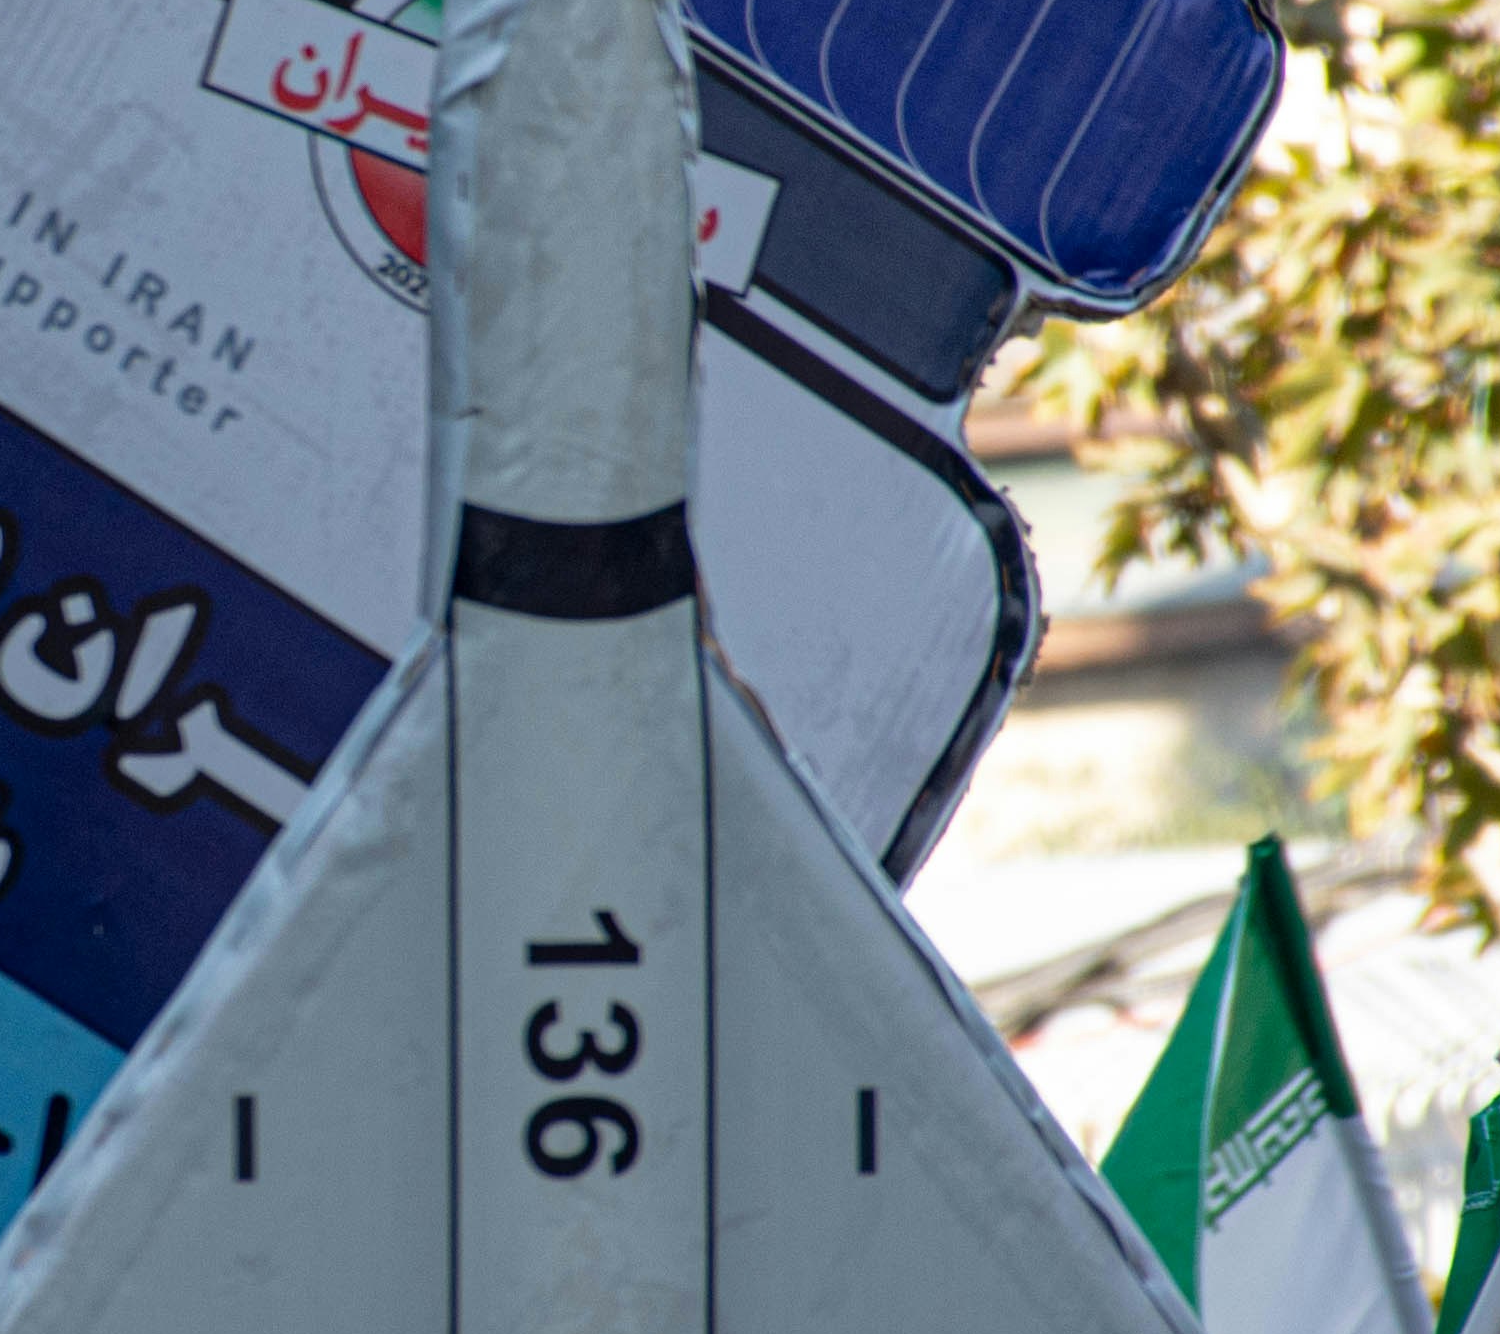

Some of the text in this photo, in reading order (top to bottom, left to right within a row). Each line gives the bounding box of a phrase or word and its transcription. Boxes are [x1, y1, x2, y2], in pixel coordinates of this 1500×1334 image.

[5, 189, 82, 259] IN
[100, 247, 258, 375] IRAN
[374, 252, 430, 298] 202
[522, 907, 643, 1183] 136
